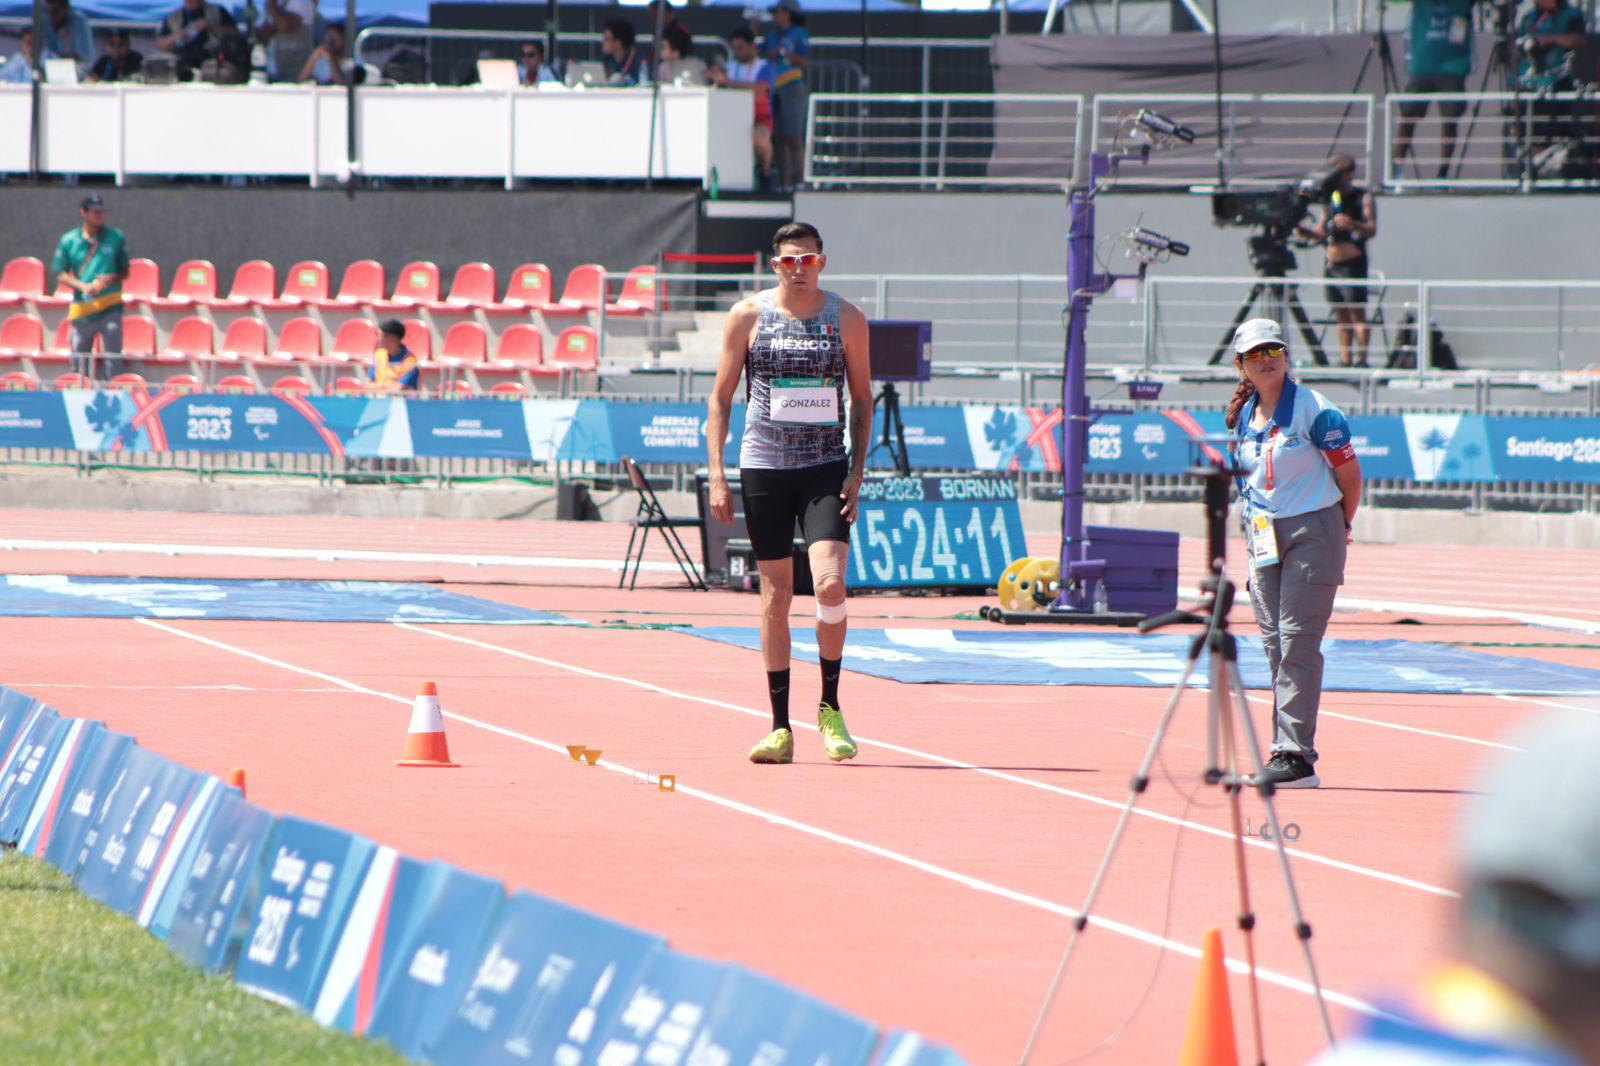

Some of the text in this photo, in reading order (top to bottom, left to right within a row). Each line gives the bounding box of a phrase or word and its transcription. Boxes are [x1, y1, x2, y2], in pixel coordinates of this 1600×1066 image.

[781, 399, 831, 408] GONZALEZ
[187, 417, 233, 440] 2023
[1088, 437, 1121, 459] 023
[1506, 435, 1573, 462] Santiago
[883, 477, 925, 500] 2023
